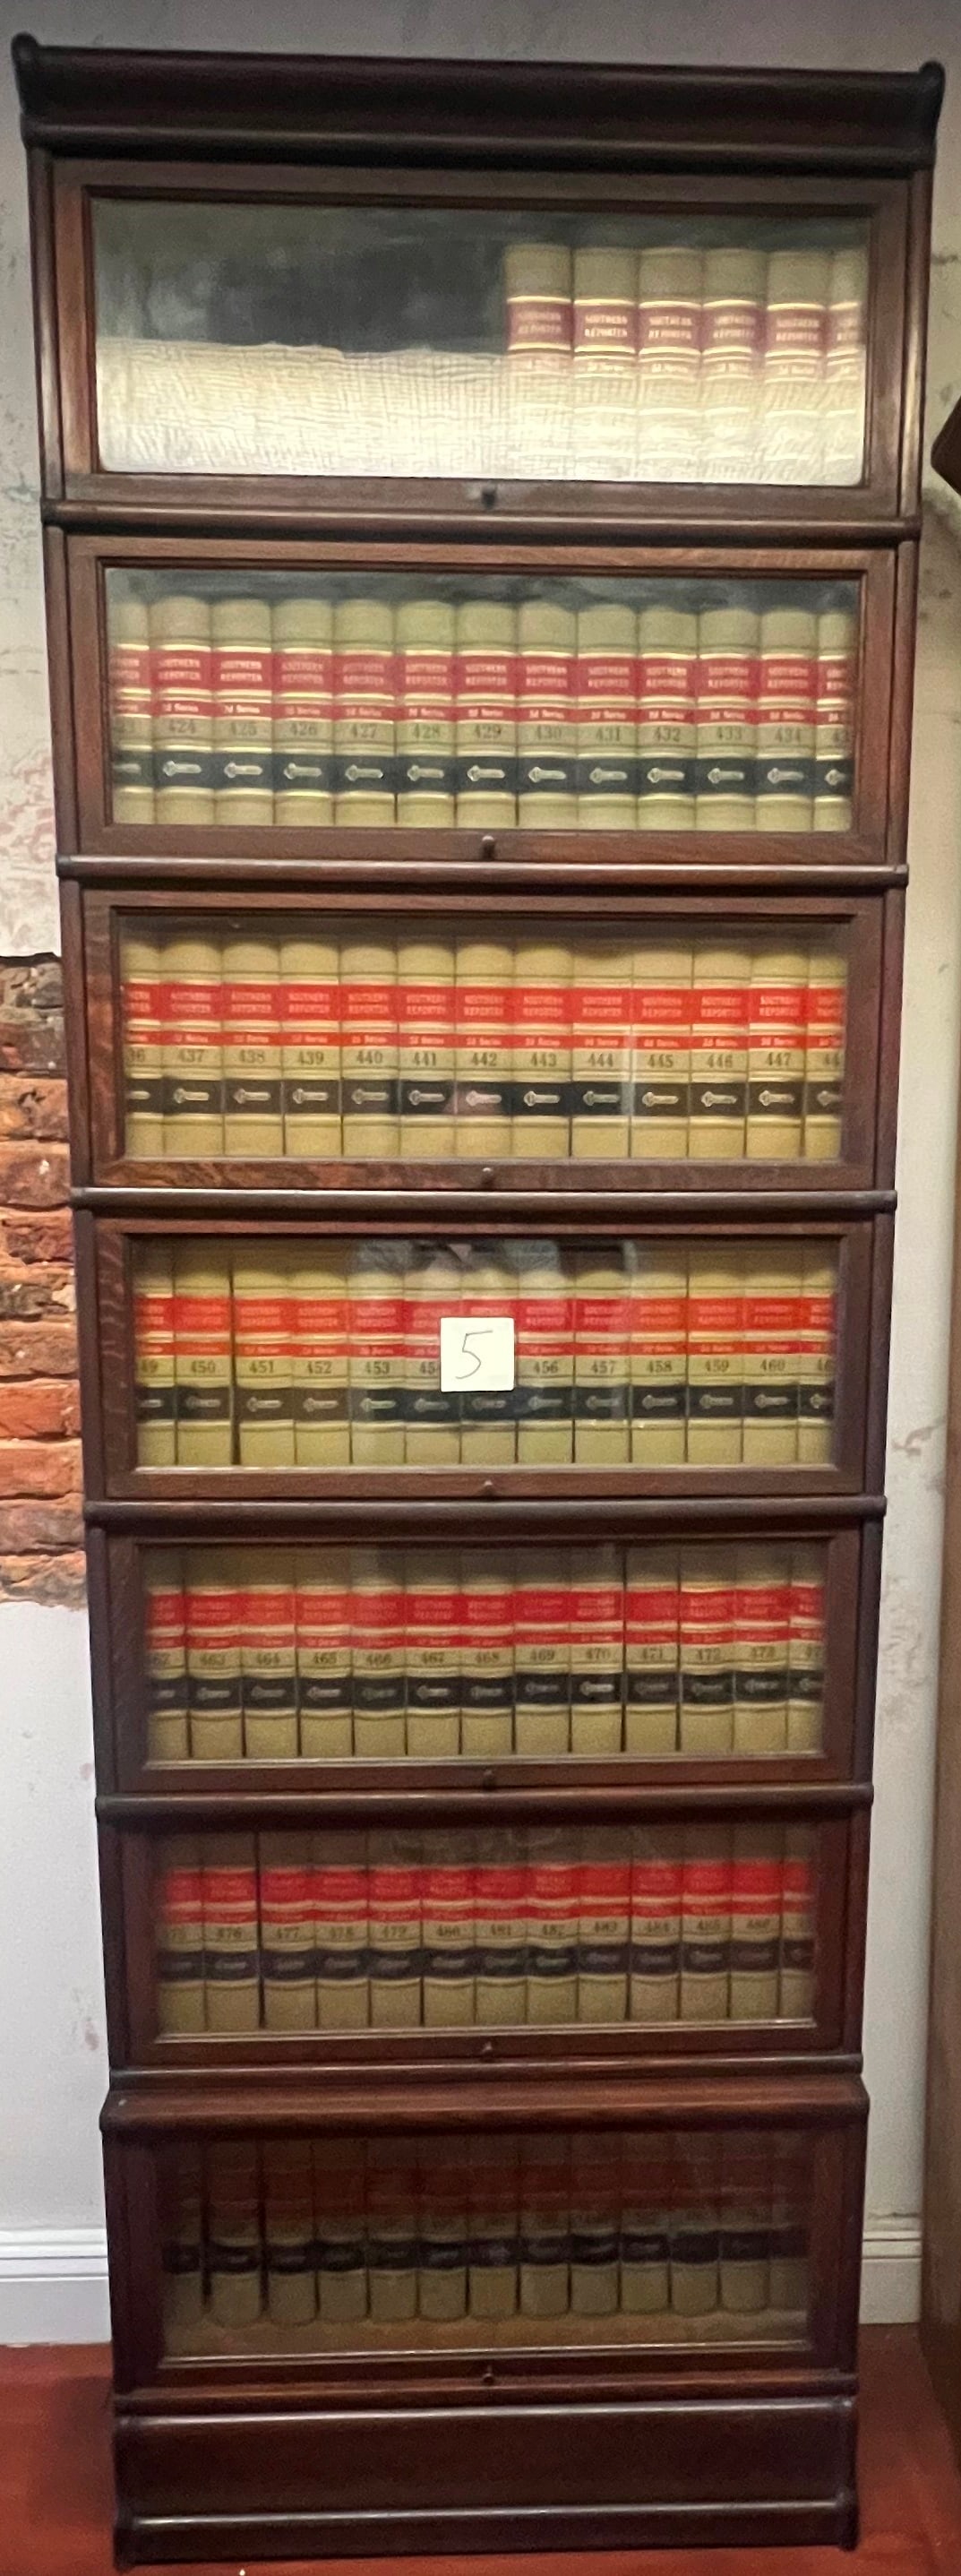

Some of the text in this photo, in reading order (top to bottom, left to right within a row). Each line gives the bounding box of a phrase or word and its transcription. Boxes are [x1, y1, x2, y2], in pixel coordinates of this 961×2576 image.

[169, 720, 196, 733] 424
[231, 722, 257, 735] 425
[289, 724, 317, 737] 426
[350, 726, 376, 738] 427
[412, 727, 440, 739] 428
[474, 727, 502, 739] 429
[536, 728, 562, 740] 430
[596, 728, 621, 741] 431
[653, 728, 681, 742] 432
[716, 728, 742, 741] 433
[775, 728, 801, 742] 434
[179, 1049, 205, 1063] 437
[239, 1050, 265, 1063] 438
[297, 1050, 324, 1064] 439
[356, 1051, 383, 1064] 440
[414, 1052, 437, 1065] 441
[470, 1052, 497, 1066] 442
[530, 1053, 556, 1066] 443
[588, 1053, 613, 1066] 444
[648, 1055, 674, 1067] 445
[707, 1054, 733, 1067] 446
[767, 1052, 791, 1066] 447
[455, 1330, 493, 1379] 5
[191, 1361, 216, 1374] 450
[249, 1361, 274, 1374] 451
[306, 1361, 332, 1374] 452
[365, 1361, 390, 1374] 453
[534, 1360, 559, 1374] 456
[591, 1360, 616, 1374] 457
[648, 1360, 673, 1374] 458
[705, 1359, 729, 1373] 459
